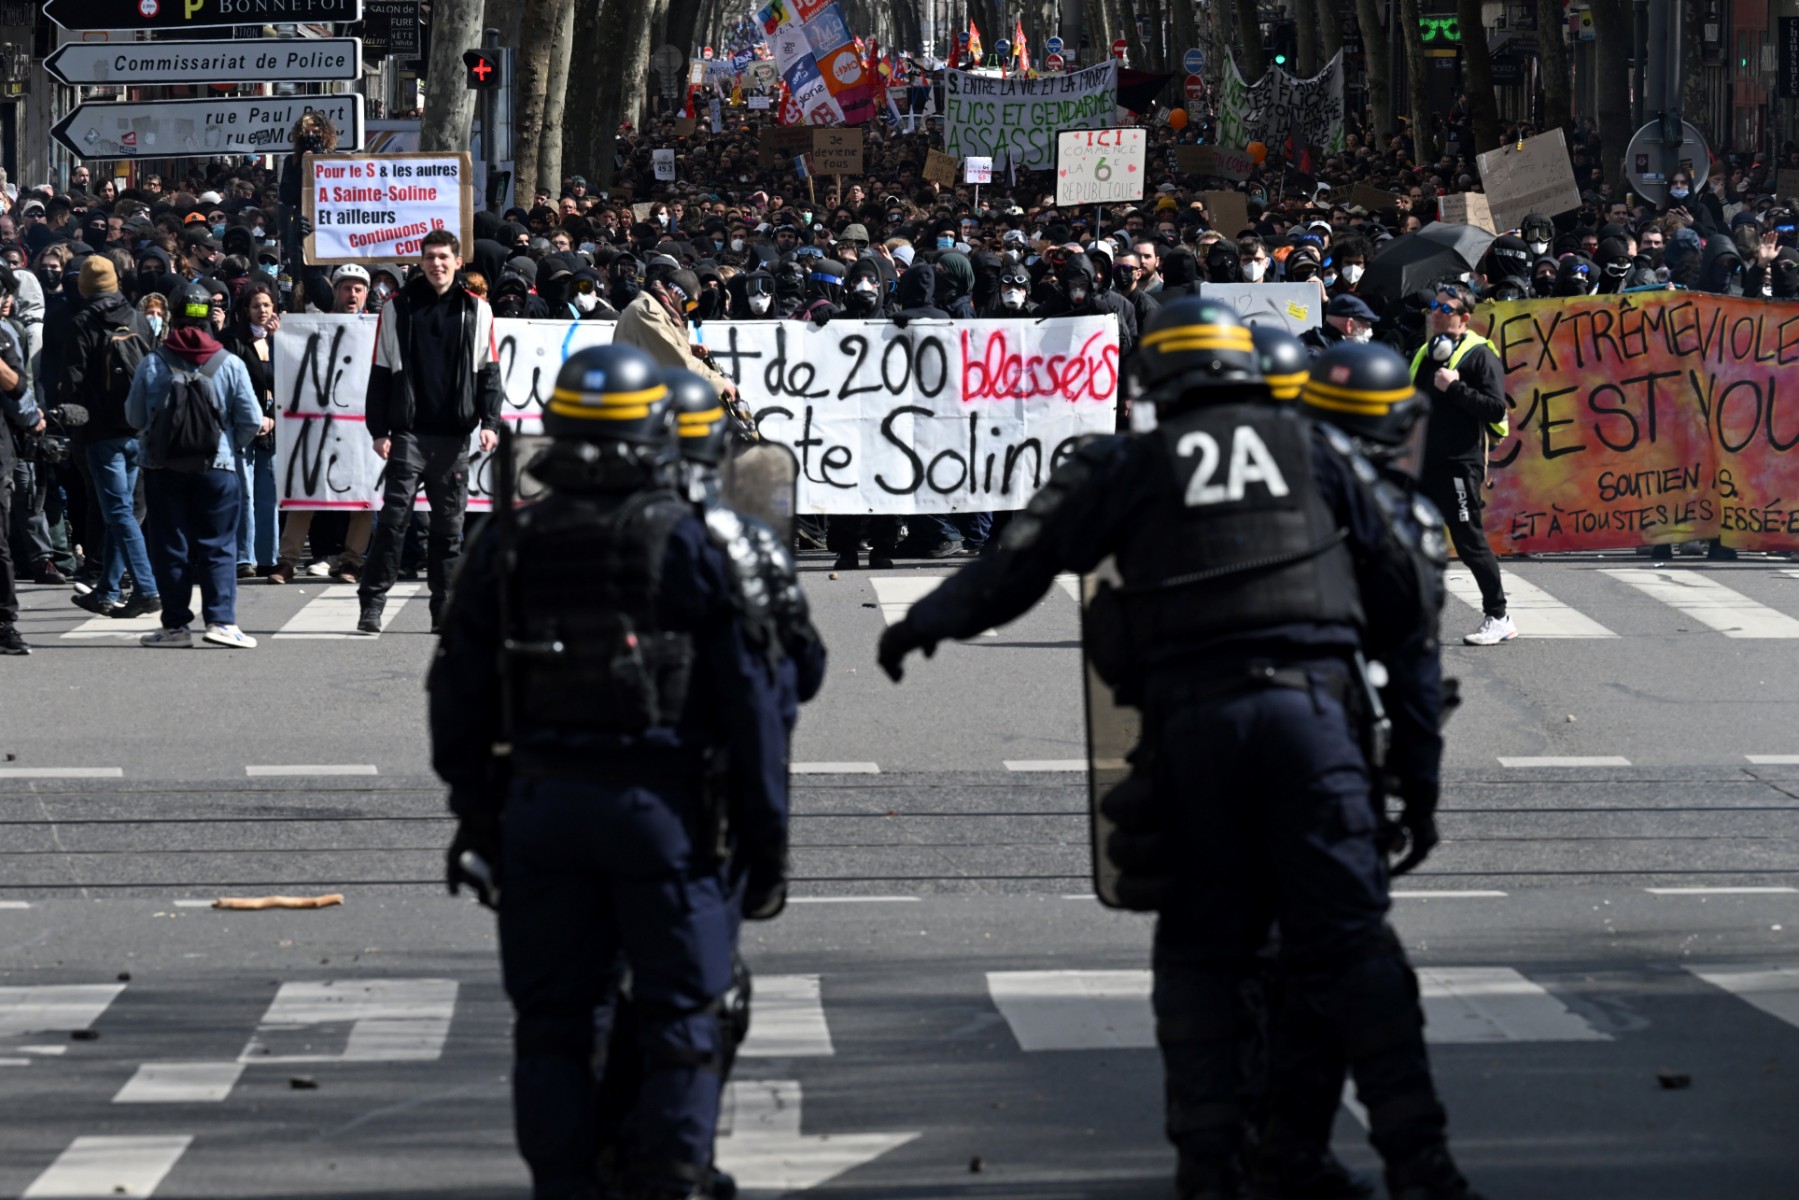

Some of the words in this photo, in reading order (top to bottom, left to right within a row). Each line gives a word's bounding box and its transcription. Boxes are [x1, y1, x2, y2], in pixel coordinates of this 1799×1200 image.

[402, 4, 414, 13] de
[114, 54, 246, 71] Commissariat
[256, 53, 277, 69] de
[287, 52, 346, 68] Police
[1789, 19, 1799, 95] chaussures
[947, 73, 960, 95] S.
[963, 79, 997, 96] ENTRE
[1001, 79, 1015, 96] LA
[1041, 77, 1054, 96] ET
[1060, 75, 1075, 93] LA
[1079, 66, 1110, 91] MORT
[206, 112, 237, 125] rue
[248, 105, 292, 123] Paul
[947, 98, 995, 126] FLICS
[1003, 103, 1026, 126] ET
[1031, 89, 1116, 126] GENDARMES
[227, 132, 257, 145] rue
[829, 135, 842, 145] Je
[1087, 130, 1122, 146] ICI
[1063, 145, 1137, 156] COMMENCE
[315, 165, 346, 179] Pour
[350, 165, 362, 178] le
[366, 163, 375, 177] S
[380, 166, 388, 177] &
[393, 164, 412, 177] les
[416, 164, 458, 177] autres
[824, 159, 848, 169] fous
[1068, 163, 1084, 174] LA
[1095, 157, 1112, 181] 6
[318, 187, 329, 202] A
[333, 185, 437, 202] Sainte-Soline
[1062, 181, 1136, 201] REPUBLIQUE
[318, 209, 332, 225] Et
[336, 208, 396, 225] ailleurs
[349, 221, 428, 248] Continuons
[431, 217, 445, 231] le
[1487, 297, 1699, 375] 'EXTRÊME
[290, 325, 352, 413] Ni
[764, 326, 830, 399] de
[838, 334, 949, 400] 200
[285, 414, 352, 498] Ni
[1176, 425, 1290, 507] 2A
[1598, 463, 1701, 501] SOUTIEN
[1511, 510, 1546, 541] ET
[1674, 500, 1714, 525] LES
